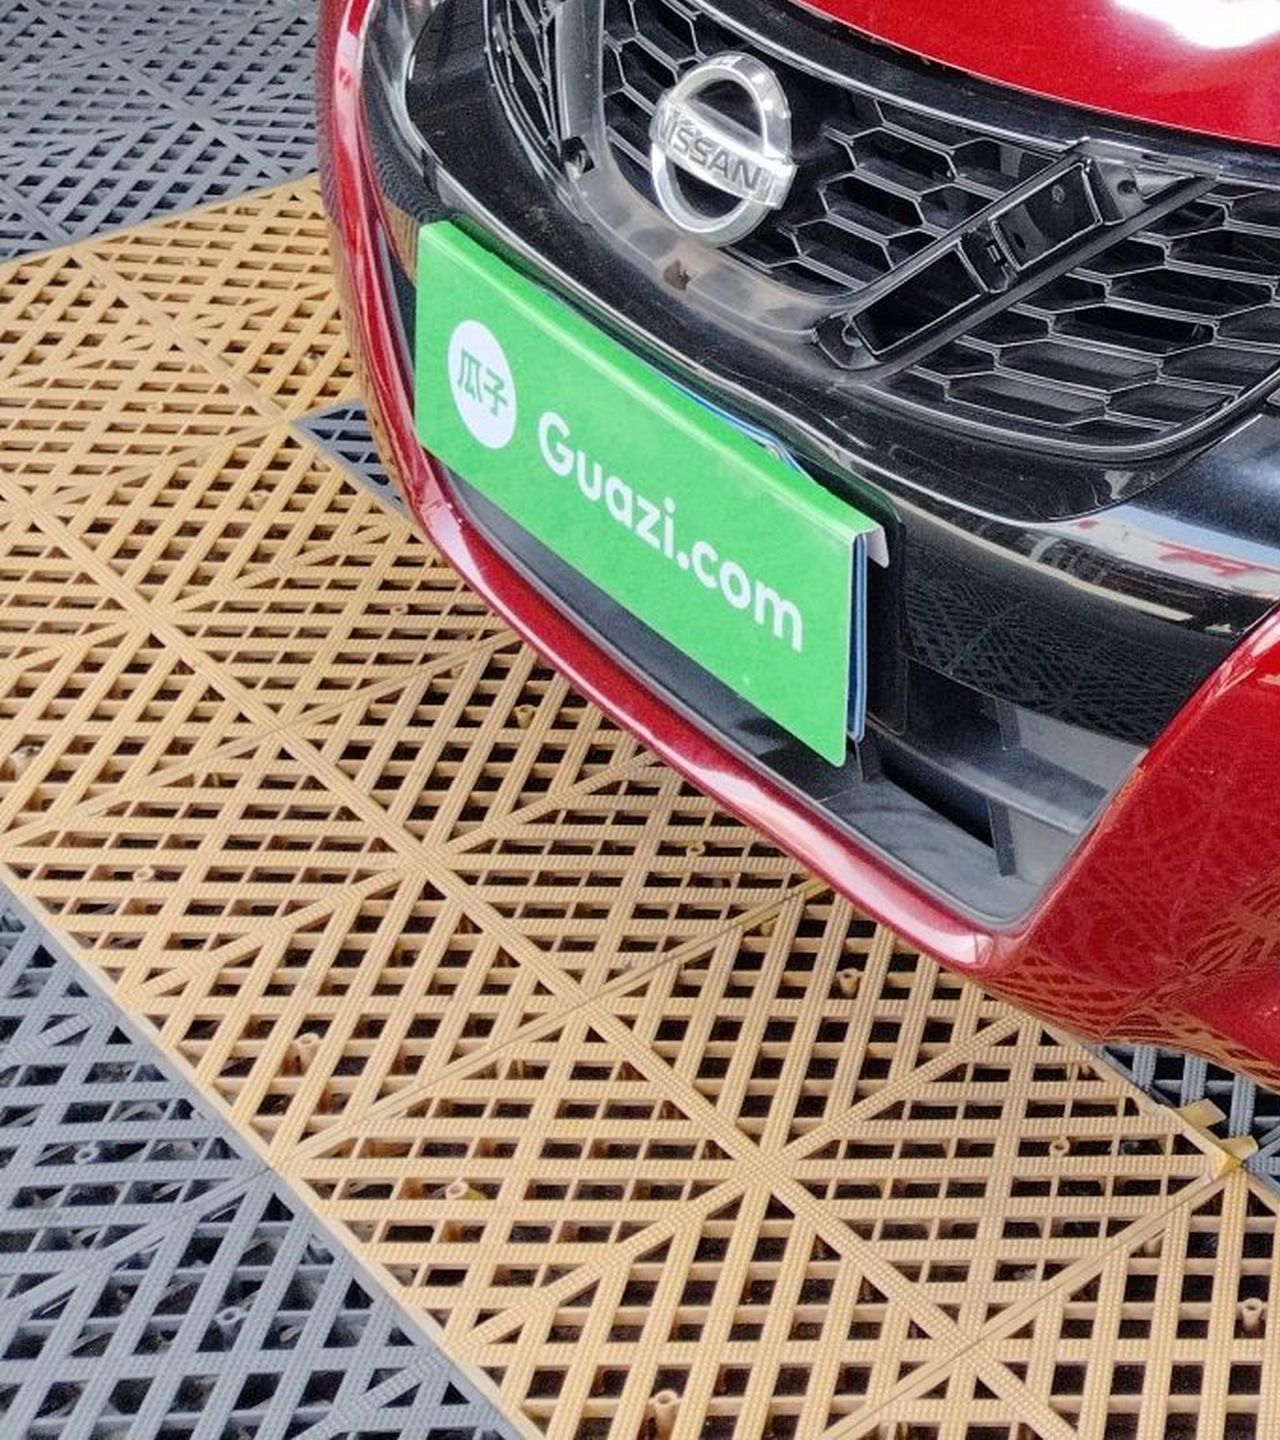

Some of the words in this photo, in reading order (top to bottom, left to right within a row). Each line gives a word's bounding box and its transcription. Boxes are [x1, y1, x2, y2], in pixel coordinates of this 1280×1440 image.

[656, 107, 763, 192] NISSAN
[457, 348, 508, 417] 瓜子
[538, 411, 803, 652] Guazi.com
